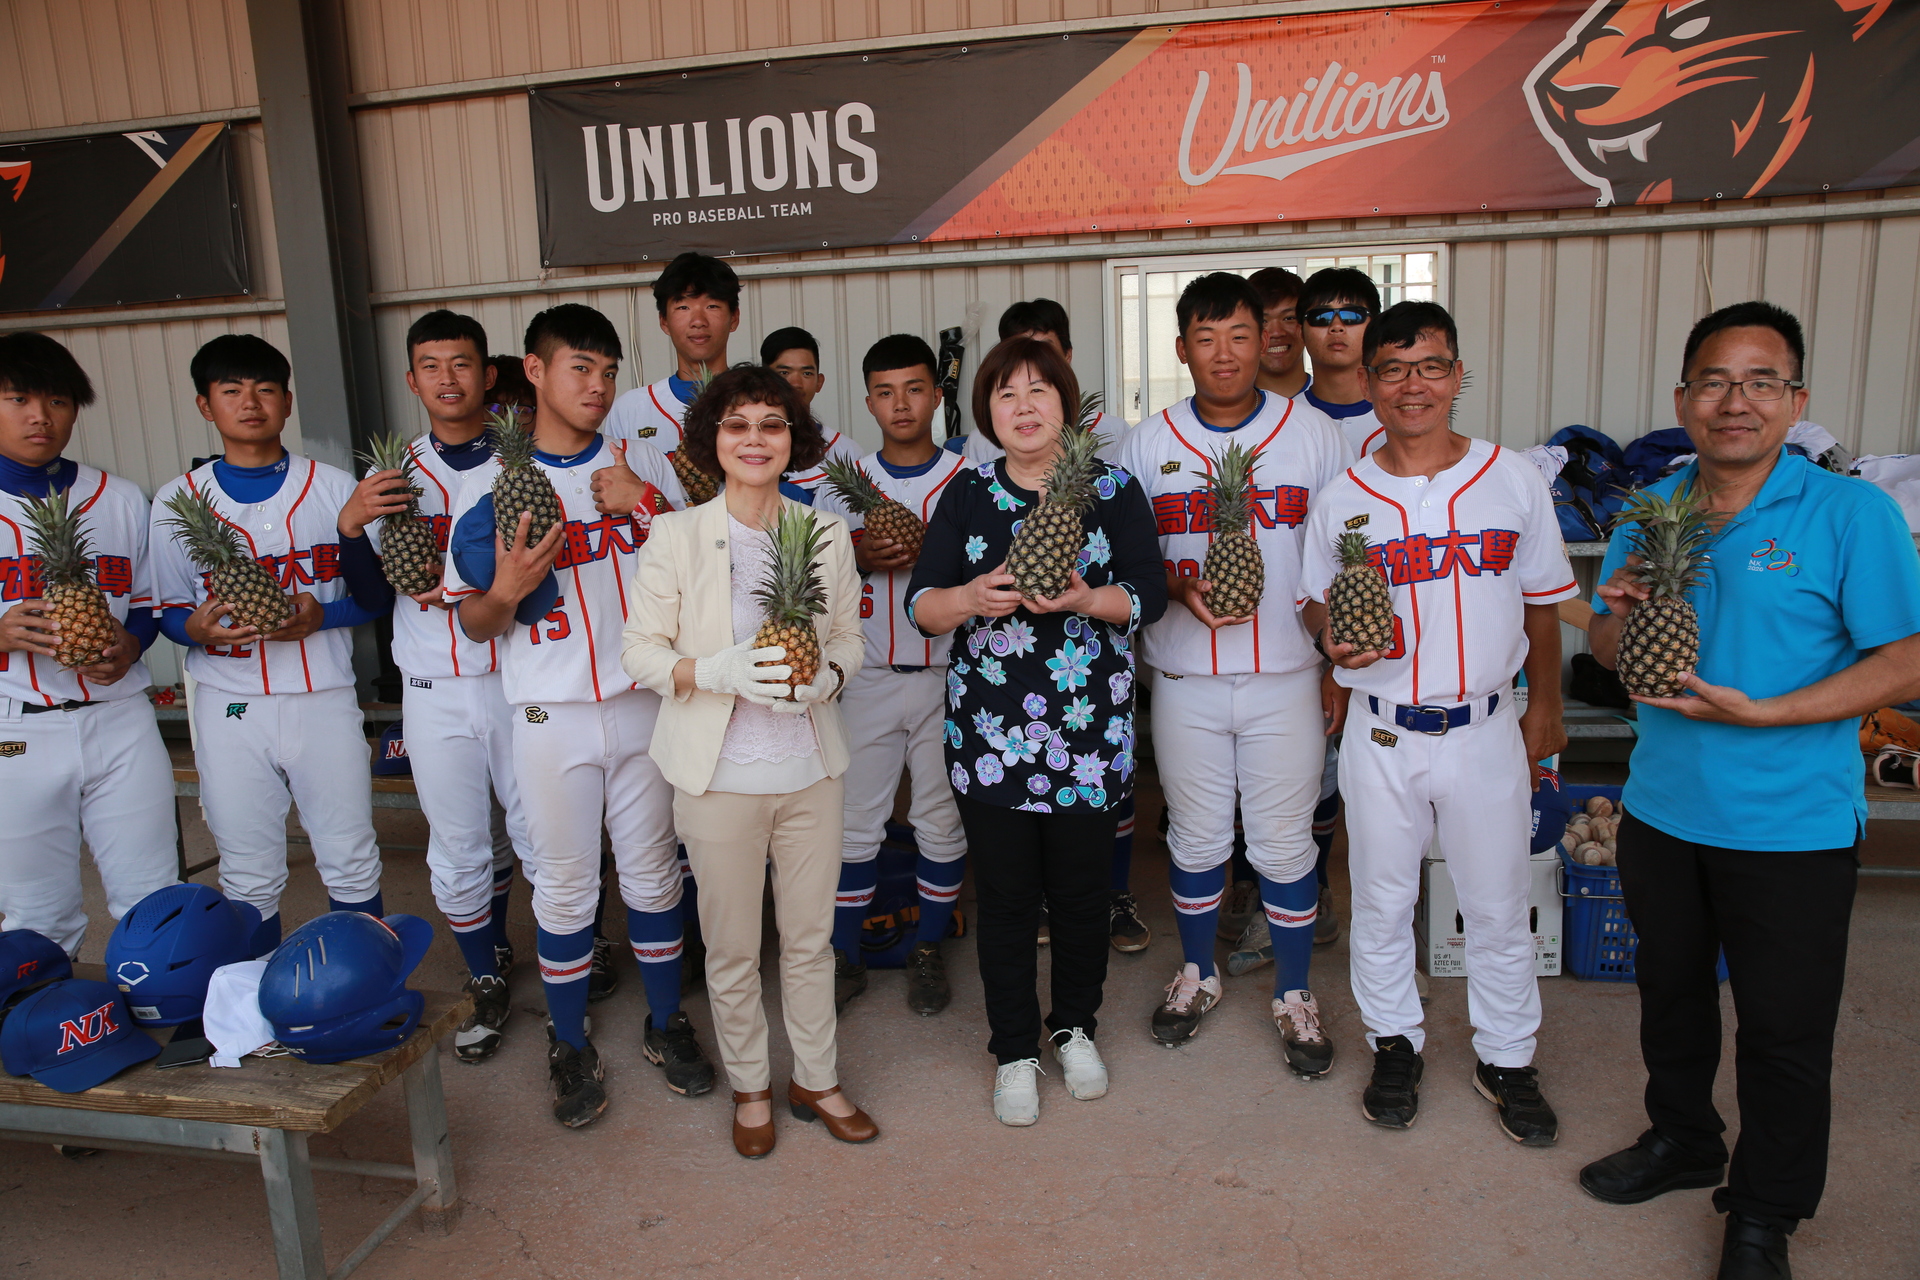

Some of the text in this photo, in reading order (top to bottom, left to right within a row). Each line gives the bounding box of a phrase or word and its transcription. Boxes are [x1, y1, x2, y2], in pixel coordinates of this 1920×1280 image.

[1431, 55, 1446, 64] TM
[1178, 60, 1450, 186] Unilions
[581, 102, 878, 213] UNILIONS
[652, 202, 812, 226] PRO BASEBALL TEAM
[1346, 516, 1369, 528] ZETT
[410, 678, 432, 689] ZETT
[1373, 731, 1397, 744] ZETT
